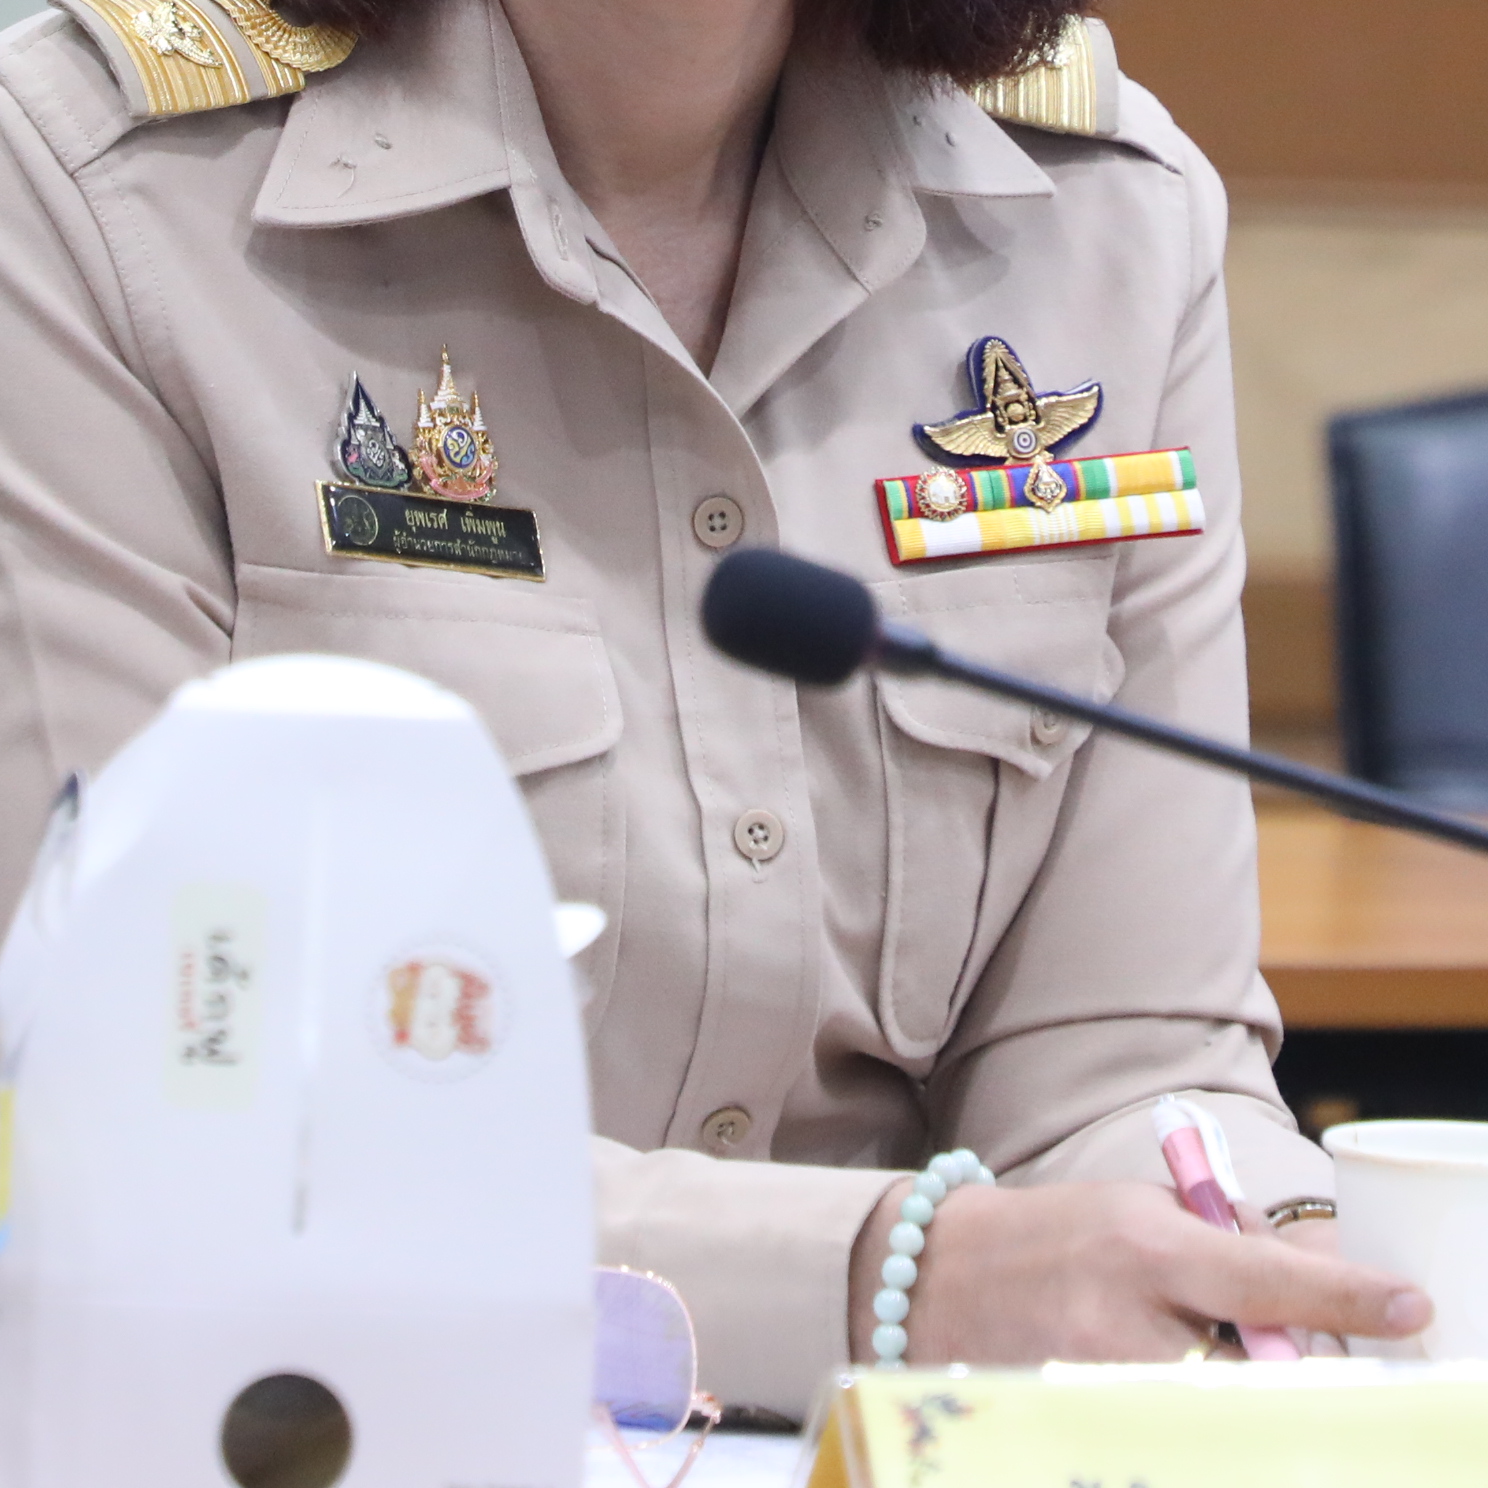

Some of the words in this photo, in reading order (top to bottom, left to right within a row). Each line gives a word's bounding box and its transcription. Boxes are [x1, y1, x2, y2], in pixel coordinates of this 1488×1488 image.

[404, 508, 449, 533] ยุพเรศ
[459, 505, 507, 545] เพิ่มพูน
